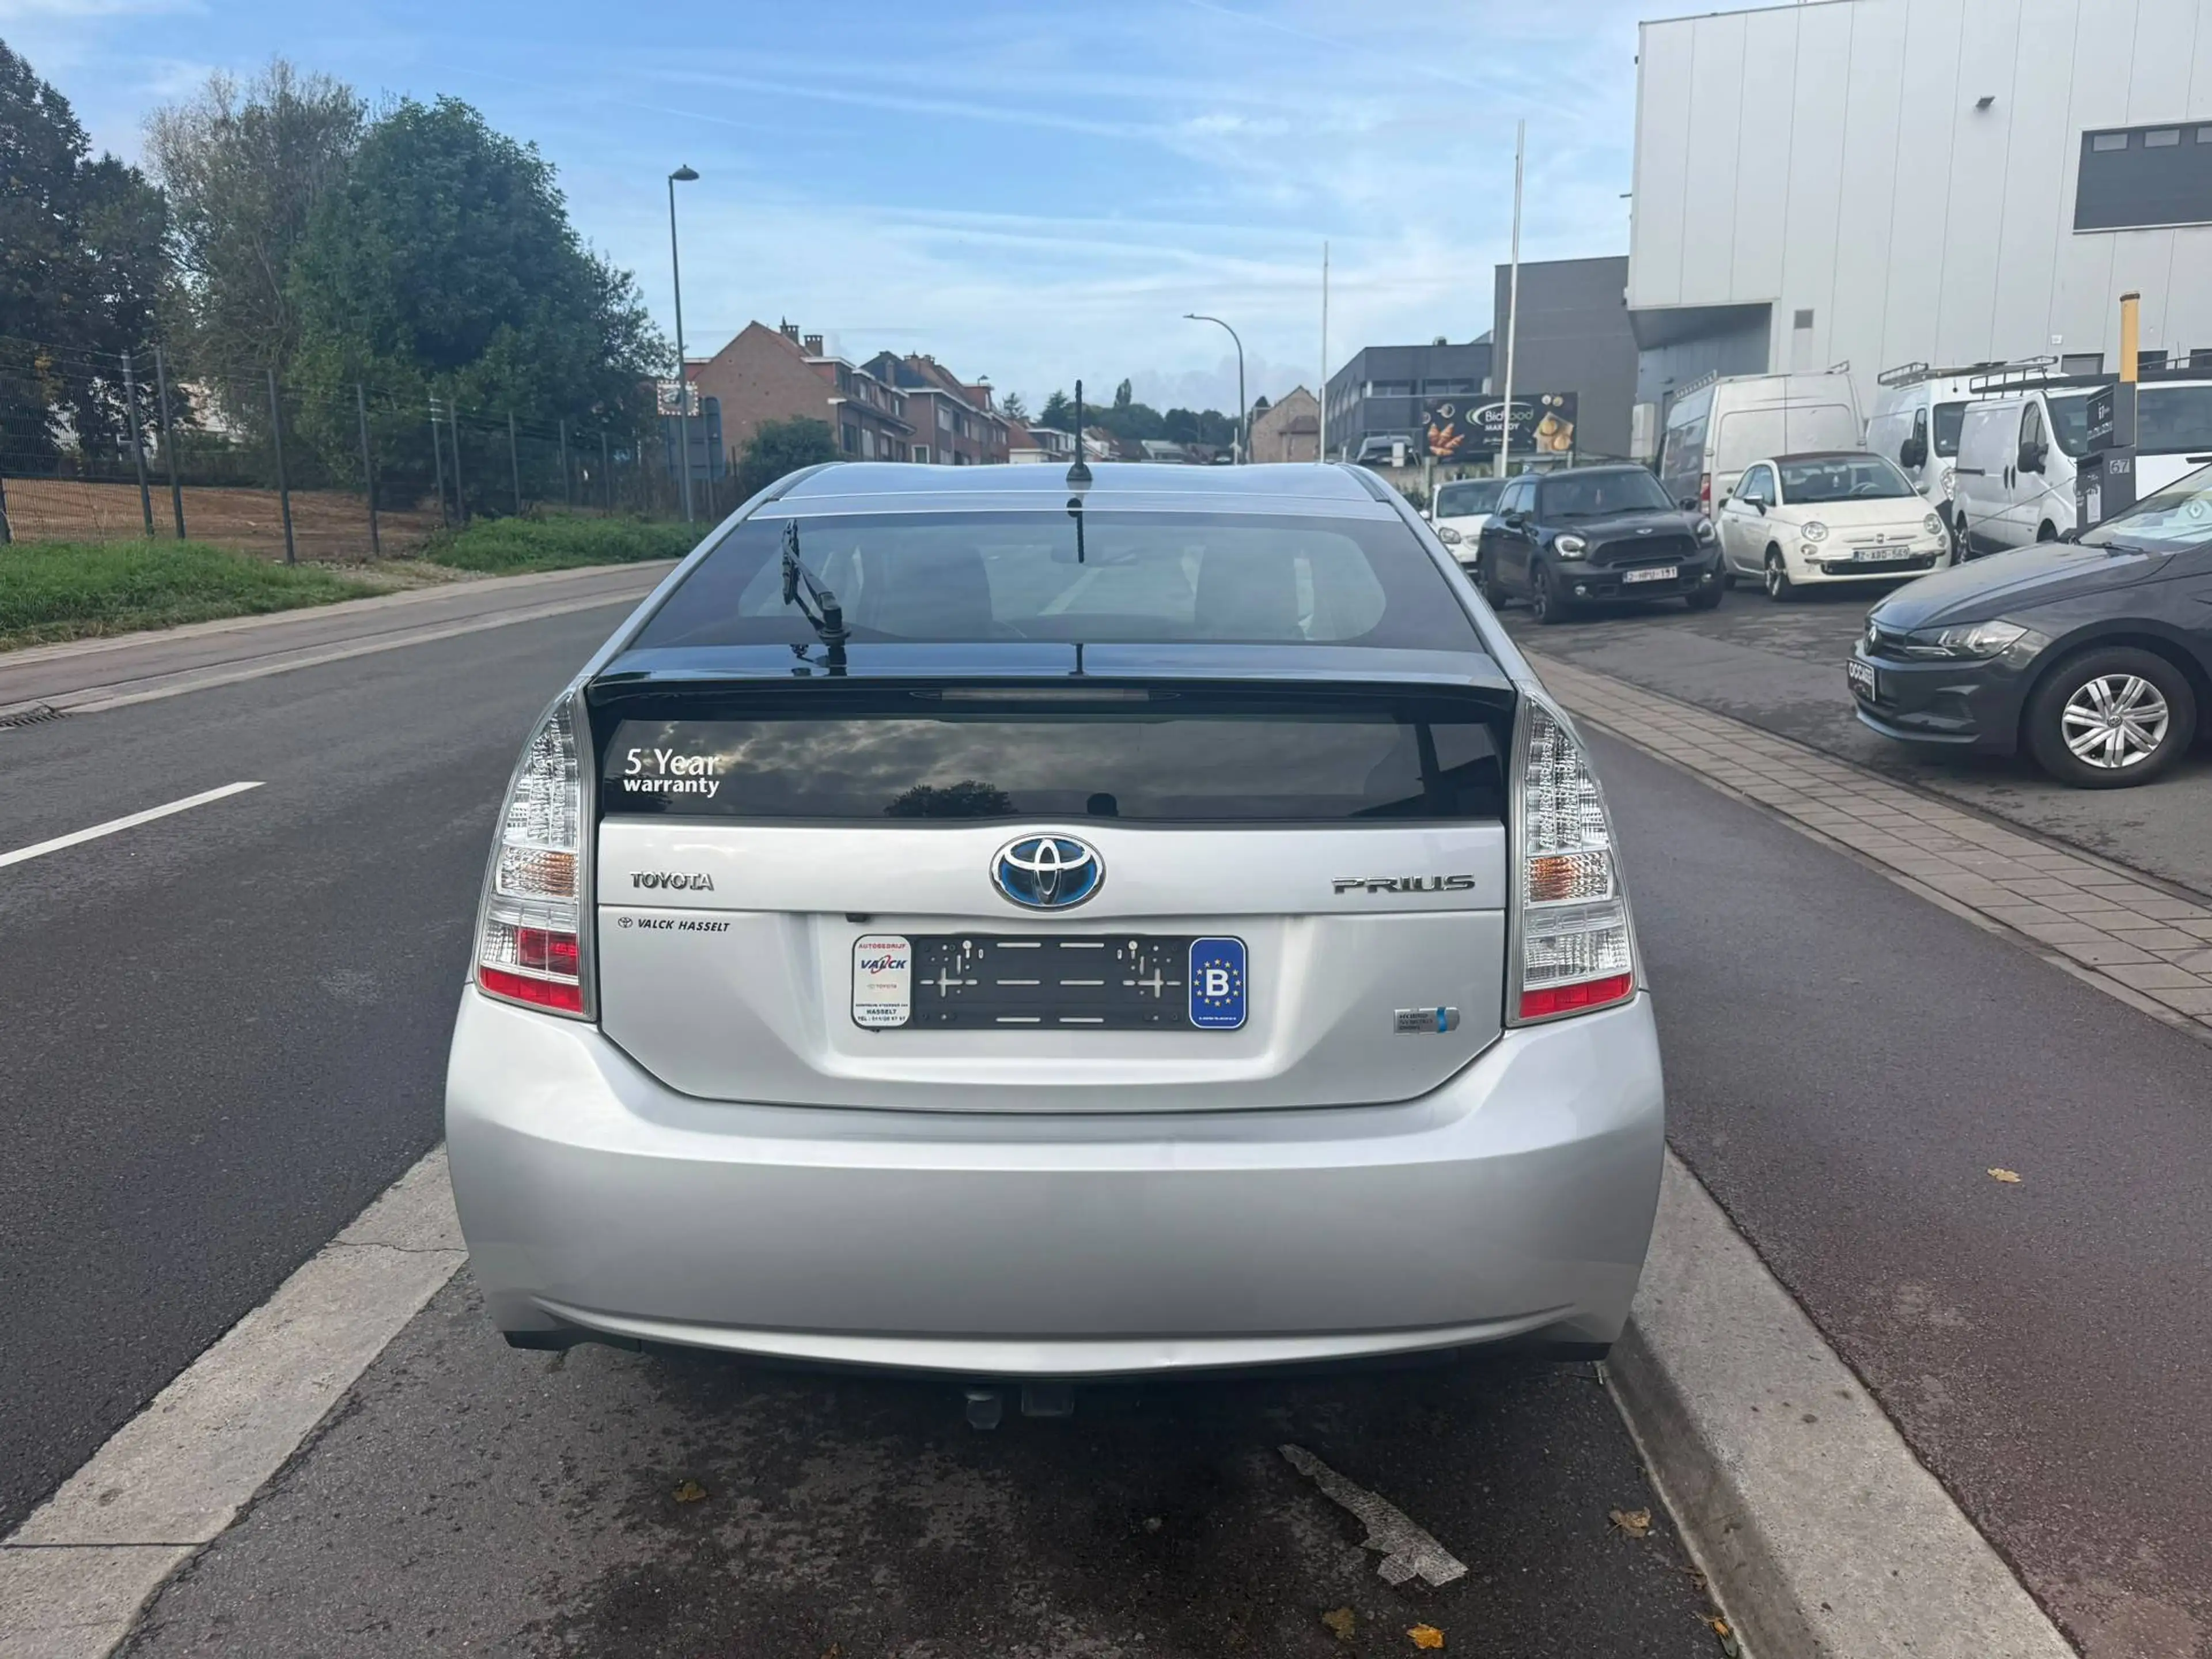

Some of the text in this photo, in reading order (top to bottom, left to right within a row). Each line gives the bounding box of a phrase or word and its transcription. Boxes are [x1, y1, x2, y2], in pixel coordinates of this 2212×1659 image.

[1485, 410, 1534, 422] Bidood
[2111, 460, 2129, 473] 67
[624, 749, 719, 775] 5 Year
[623, 778, 719, 798] warranty
[630, 871, 714, 891] TOYOTA
[1332, 873, 1475, 895] PRIUS
[638, 918, 730, 932] VALCK HASSELT
[861, 959, 907, 970] VALCK
[1205, 969, 1229, 997] B
